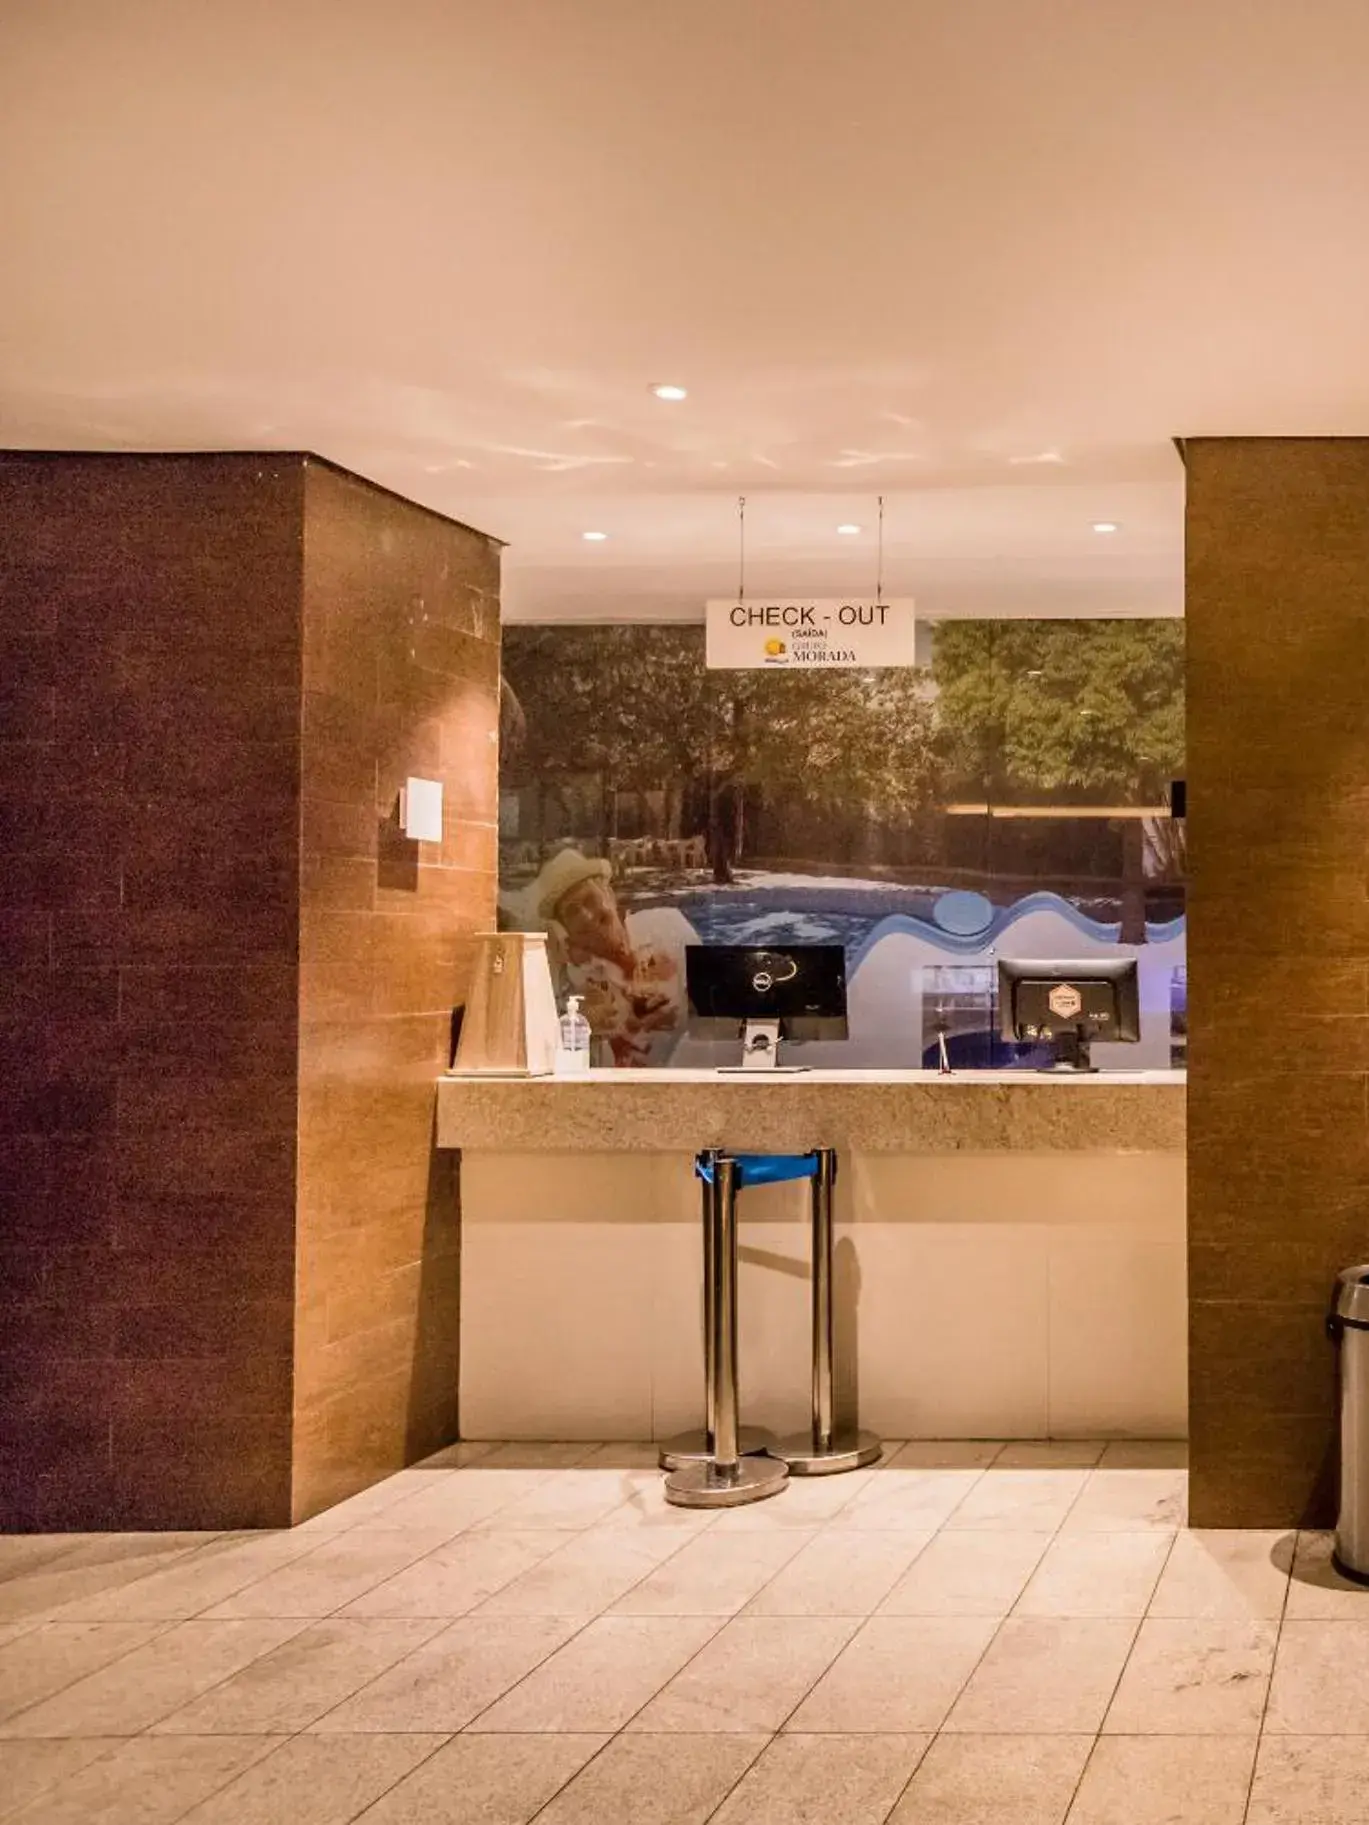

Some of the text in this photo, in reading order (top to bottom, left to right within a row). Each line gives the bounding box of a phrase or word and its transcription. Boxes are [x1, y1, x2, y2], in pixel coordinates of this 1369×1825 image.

[729, 607, 815, 626] CHECK
[838, 605, 890, 626] OUT
[793, 650, 857, 663] MORADA
